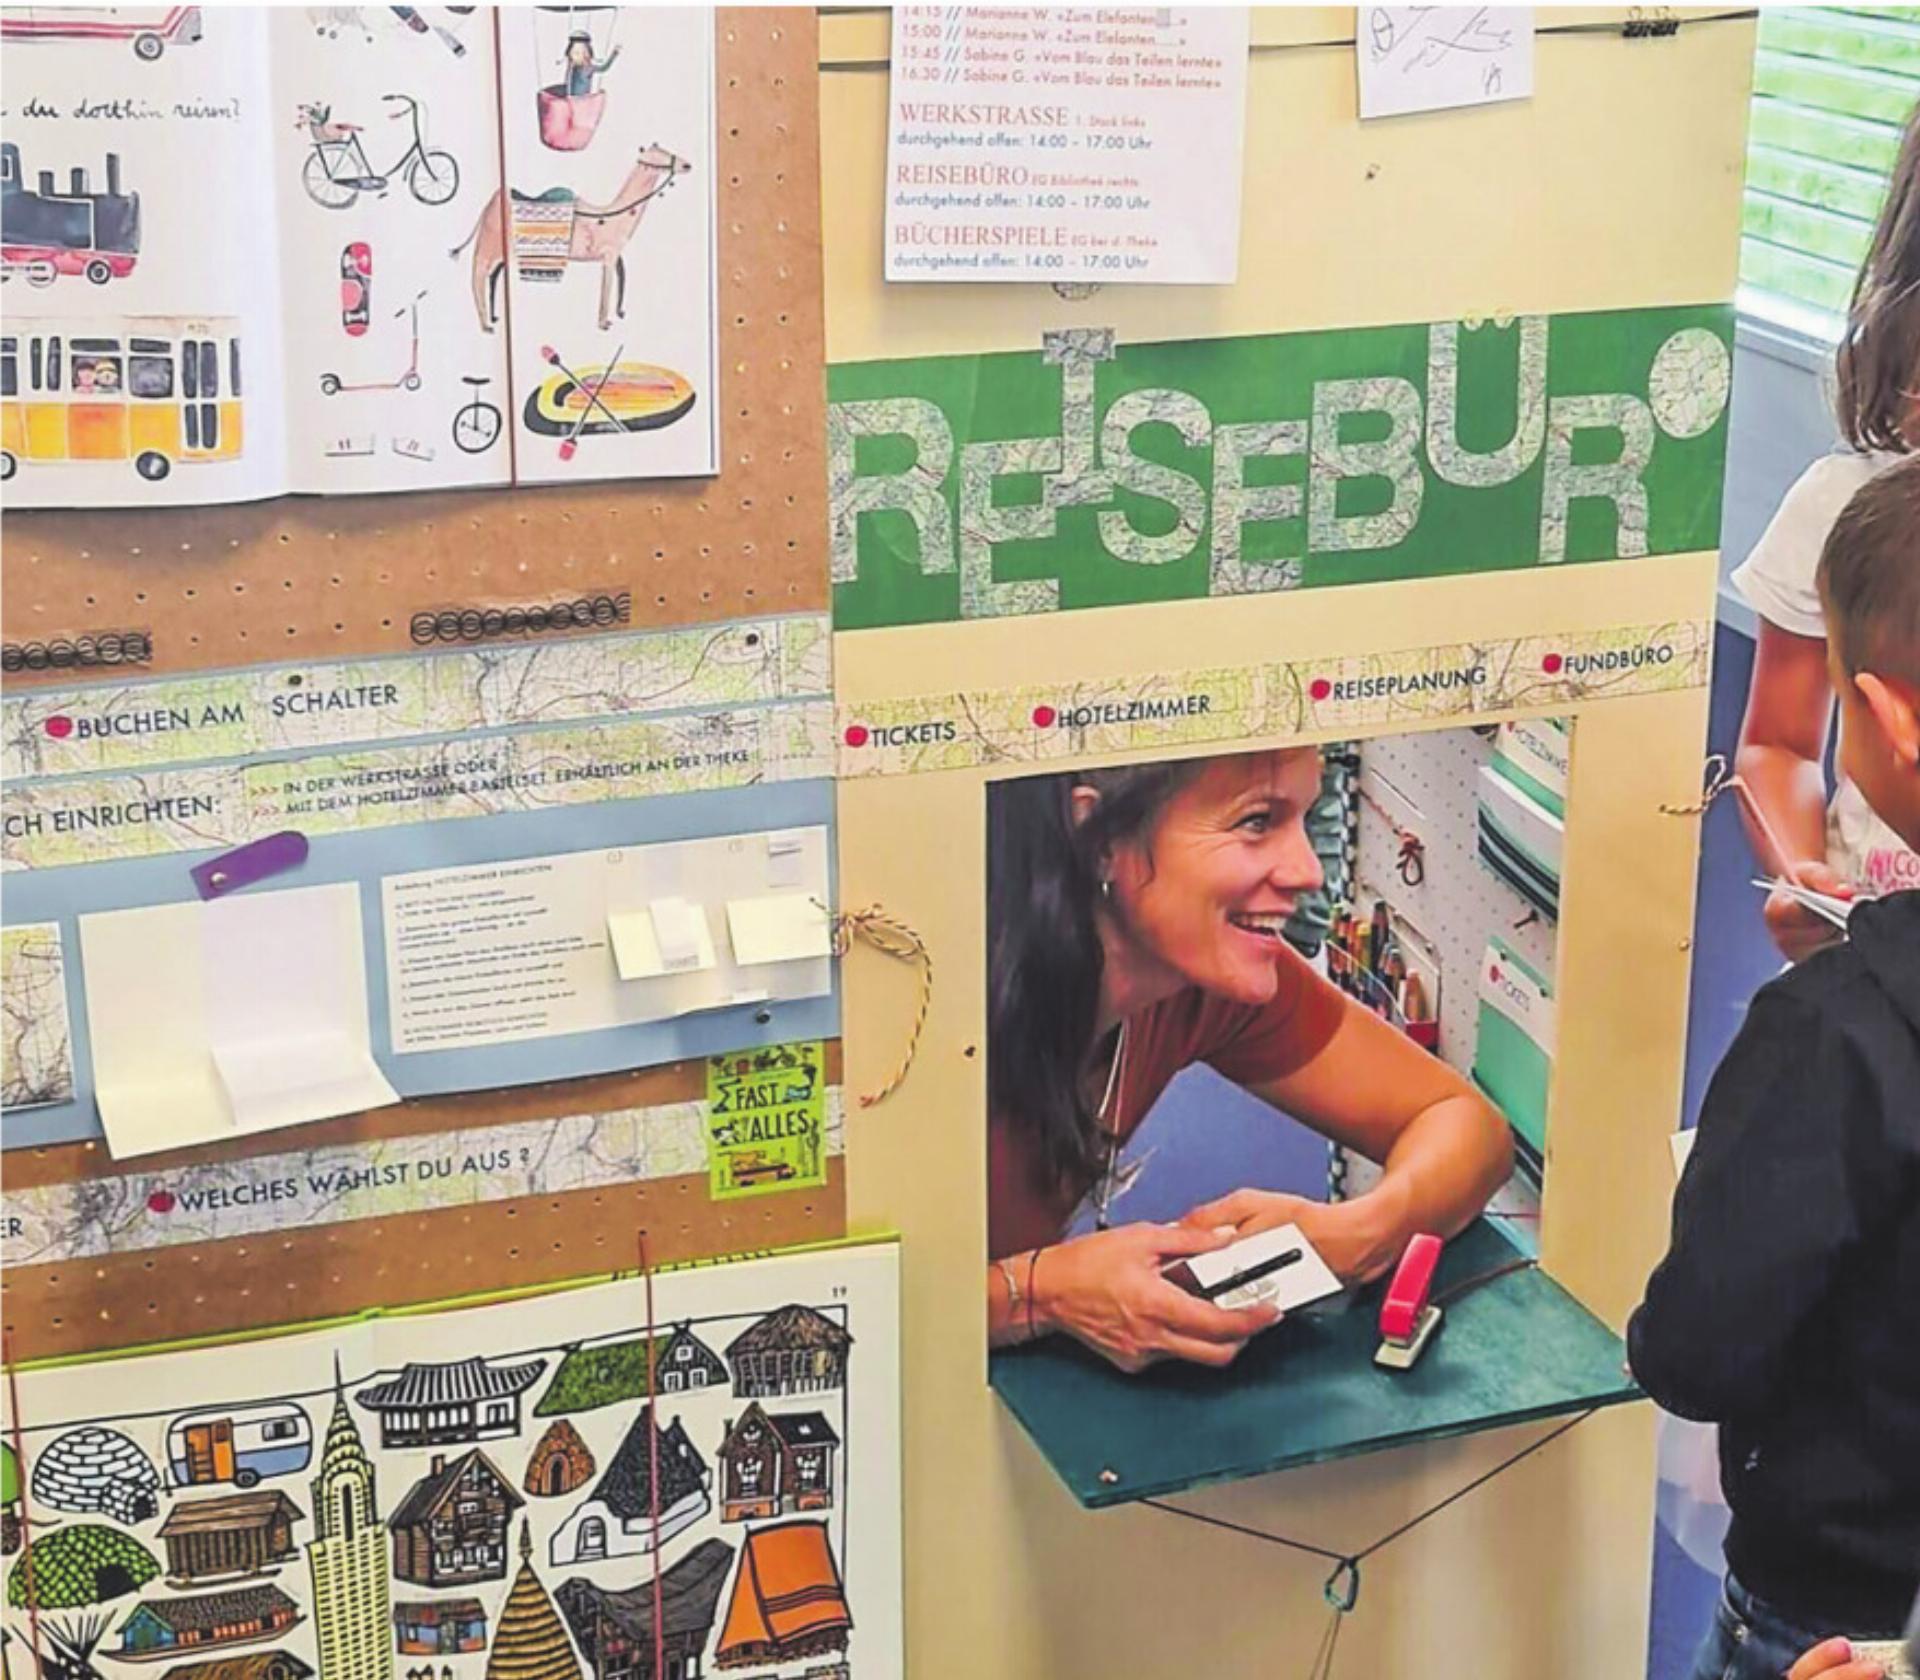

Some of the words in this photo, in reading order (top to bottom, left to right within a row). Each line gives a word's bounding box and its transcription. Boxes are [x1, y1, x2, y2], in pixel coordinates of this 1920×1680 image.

[902, 24, 941, 38] 15:00
[965, 26, 1028, 40] Marianne
[964, 47, 1009, 61] Sabine
[1106, 52, 1130, 66] das
[1135, 53, 1173, 66] Teilen
[963, 67, 1008, 82] Sabine
[1106, 73, 1129, 86] das
[1134, 74, 1172, 87] Teilen
[900, 103, 1068, 127] WERKSTRASSE
[897, 132, 983, 149] durchgehend
[987, 134, 1024, 147] offen:
[1030, 134, 1067, 148] 14:00
[1086, 135, 1125, 149] 17:00
[1128, 136, 1152, 149] Uhr
[896, 161, 1029, 186] REISEBÜRO
[895, 192, 981, 210] durchgehend
[985, 194, 1022, 208] offen:
[1027, 194, 1066, 208] 14:00
[1084, 196, 1123, 209] 17:00
[1127, 196, 1151, 210] Uhr
[894, 221, 1068, 247] BÜCHERSPIELE
[893, 251, 979, 270] durchgehend
[983, 253, 1019, 267] offen:
[1025, 254, 1063, 268] 14:00
[1083, 254, 1121, 269] 17:00
[1125, 254, 1149, 270] Uhr
[830, 314, 1731, 619] REISEBÜRO
[1564, 644, 1673, 675] FUNDBÜRO
[1333, 666, 1487, 701] REISEPLANUNG
[78, 706, 190, 740] BUCHEN
[200, 702, 246, 725] AM
[271, 684, 400, 718] SCHALTER
[1058, 694, 1211, 730] HOTELZIMMER
[869, 720, 956, 748] TICKETS
[283, 781, 301, 794] IN
[307, 777, 336, 793] DER
[342, 762, 450, 788] WERKSTRASSE
[454, 757, 498, 776] ODER
[318, 797, 351, 812] DEM
[357, 780, 467, 808] HOTELZIMMER
[556, 759, 642, 784] ERHÄLTLICH
[646, 758, 670, 773] AN
[673, 755, 701, 770] DER
[705, 749, 750, 766] THEKE
[5, 812, 43, 838] CH
[53, 796, 223, 833] EINRICHTEN:
[750, 1108, 810, 1142] ALLES
[178, 1178, 299, 1213] WELCHES
[306, 1162, 410, 1195] WÄHLST
[418, 1158, 453, 1182] DU
[463, 1152, 512, 1175] AUS
[519, 1147, 531, 1168] ?
